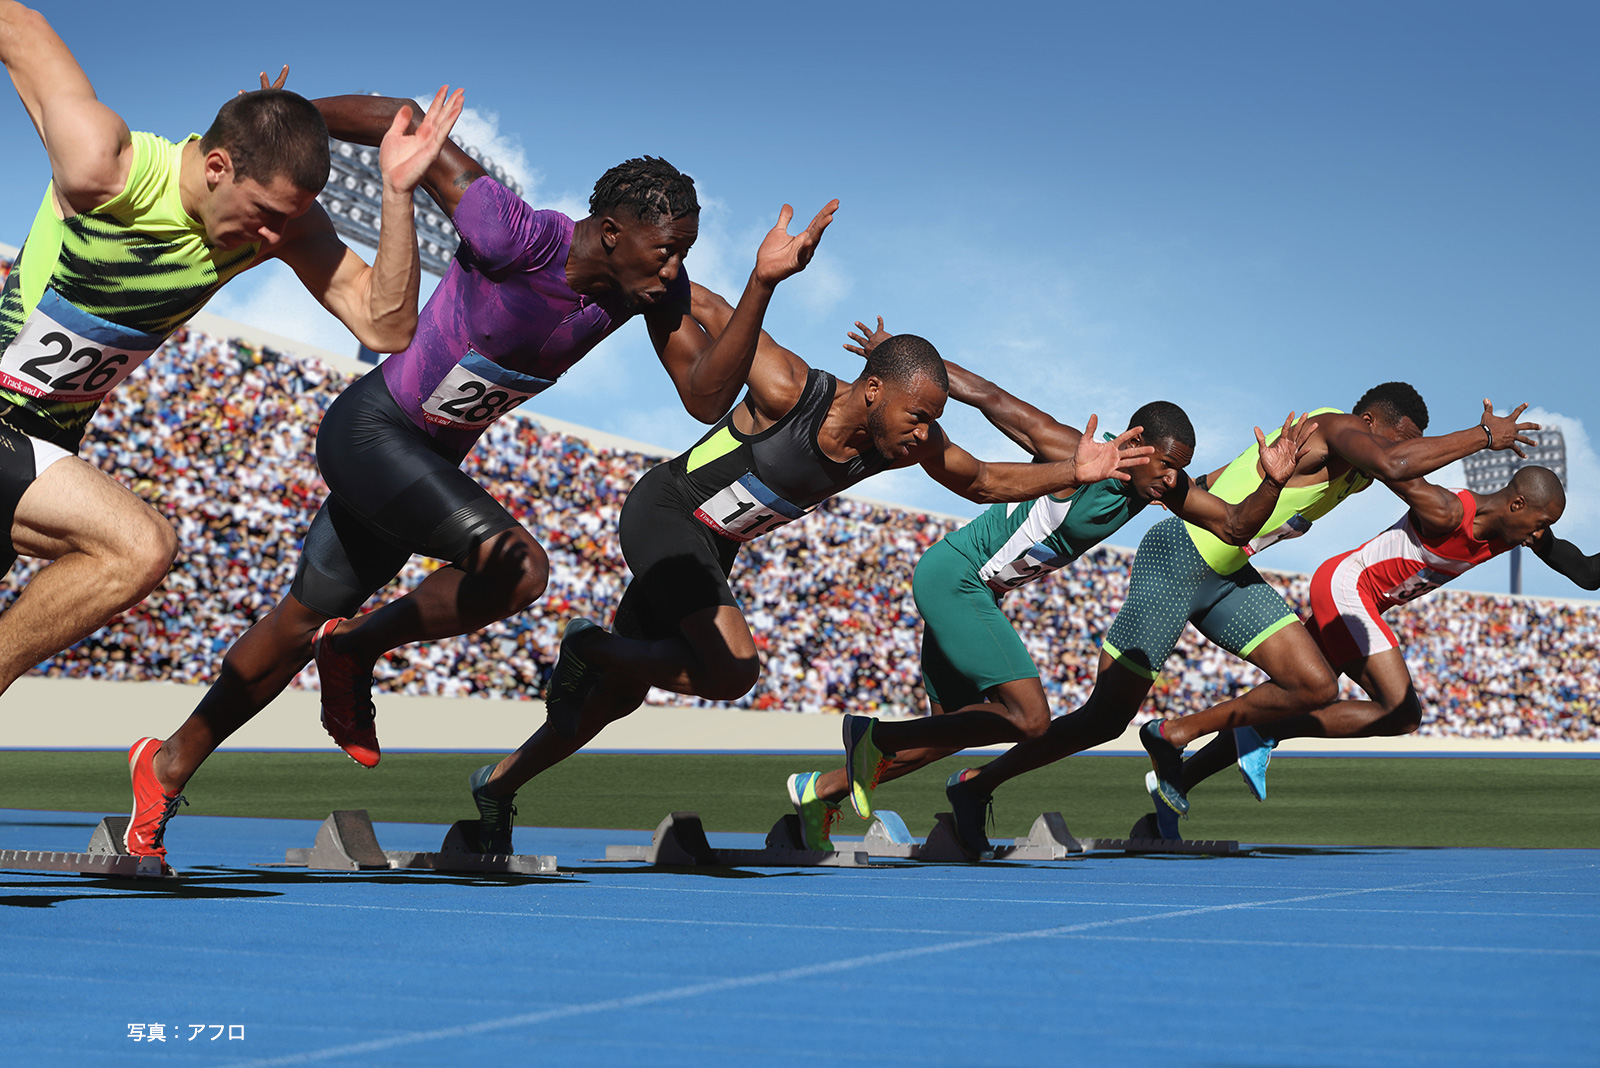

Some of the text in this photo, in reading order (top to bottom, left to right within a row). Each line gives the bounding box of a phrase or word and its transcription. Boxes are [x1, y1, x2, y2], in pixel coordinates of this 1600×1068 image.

[19, 331, 129, 392] 226
[3, 374, 23, 391] Track
[22, 385, 39, 397] and
